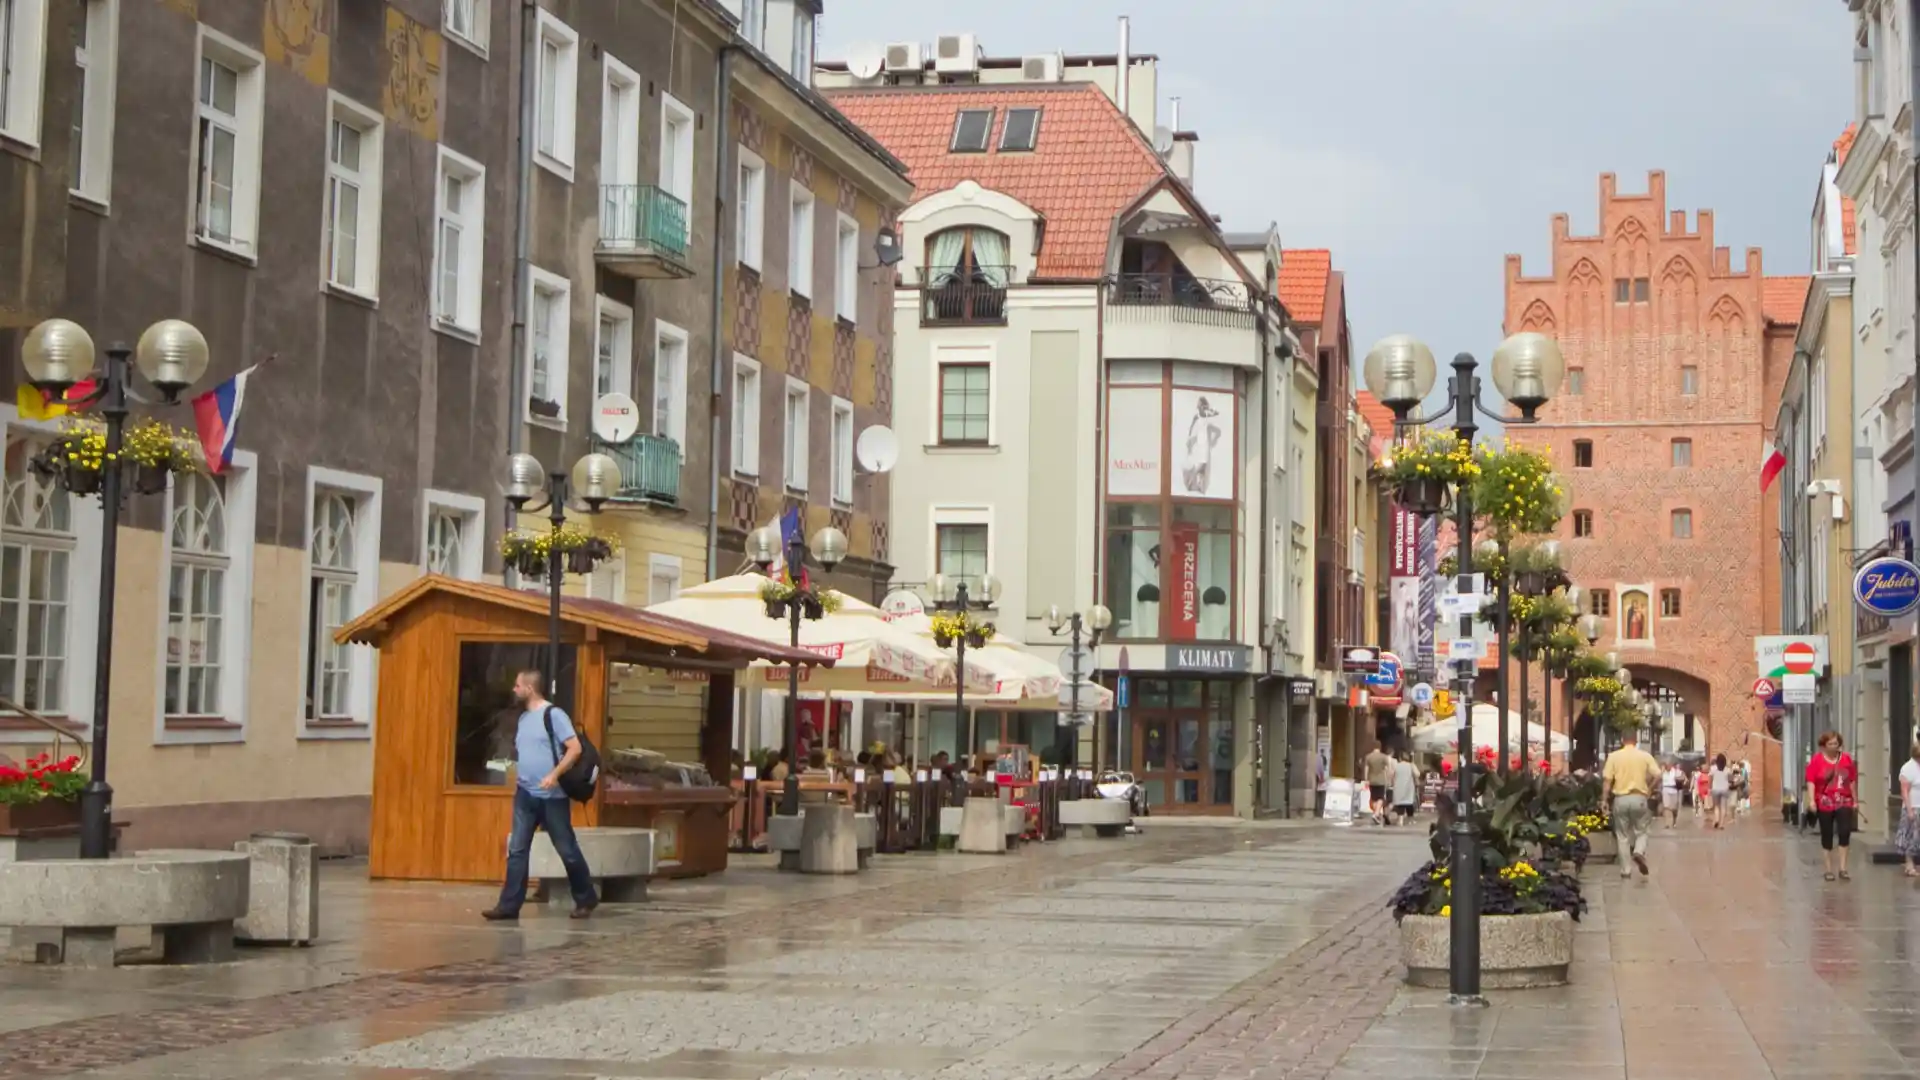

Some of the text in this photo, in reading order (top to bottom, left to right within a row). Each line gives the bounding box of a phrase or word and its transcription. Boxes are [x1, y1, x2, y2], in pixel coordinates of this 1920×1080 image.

[1405, 512, 1415, 546] ŚLUBNYC
[1183, 542, 1194, 621] PRZECENA
[1866, 572, 1916, 600] Jubiler
[1178, 649, 1236, 667] KLIMATY
